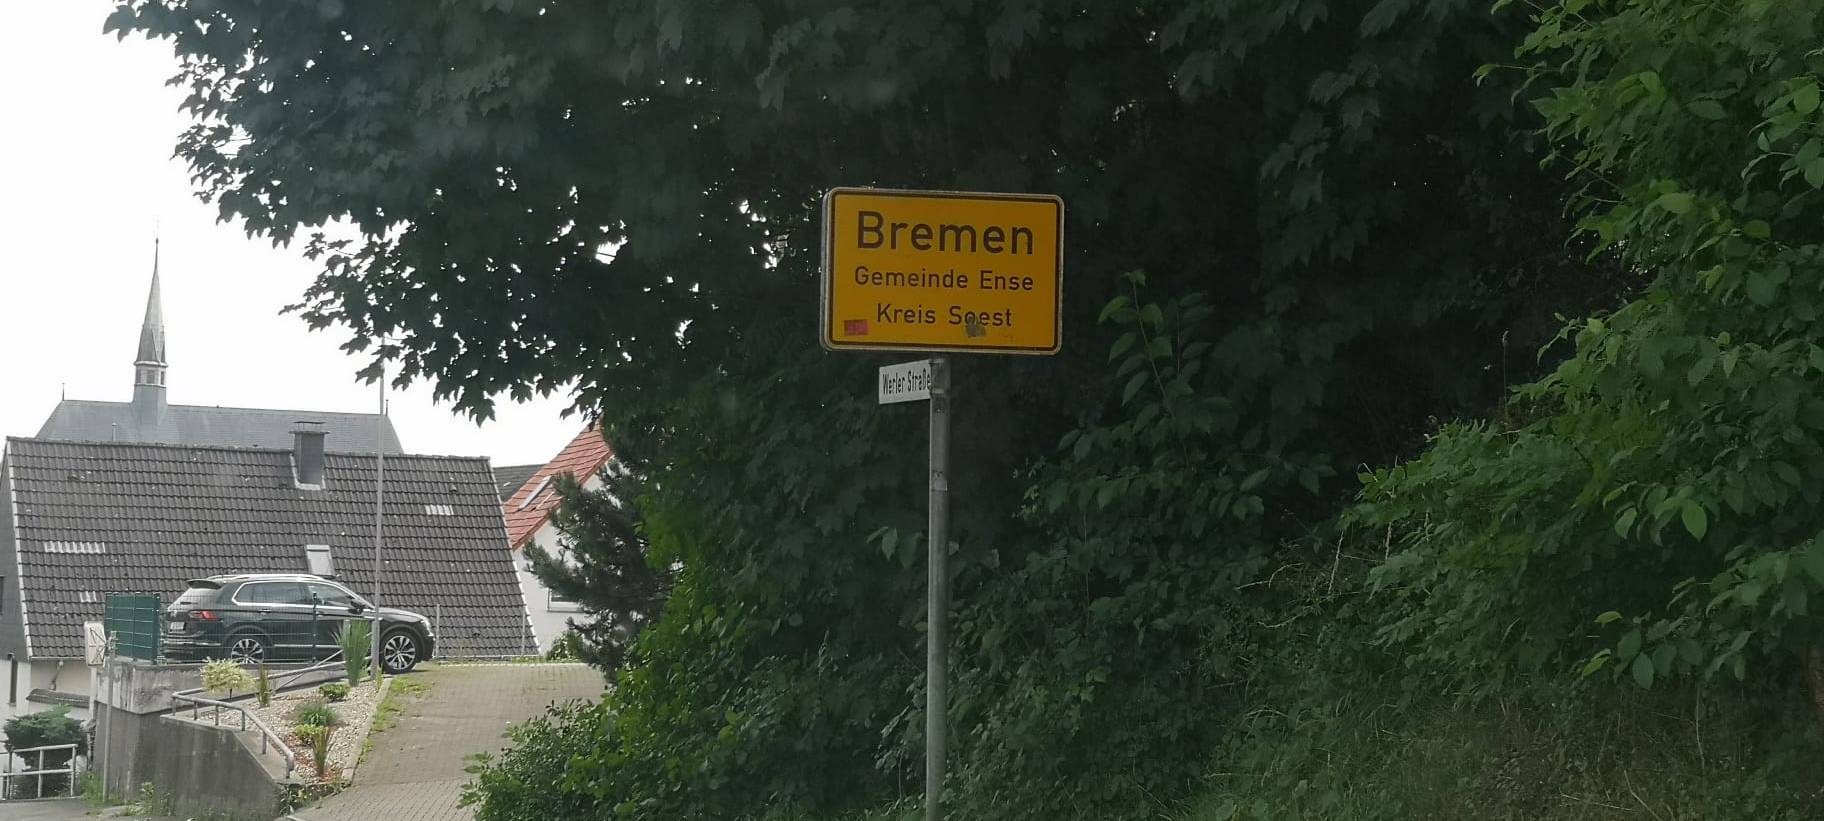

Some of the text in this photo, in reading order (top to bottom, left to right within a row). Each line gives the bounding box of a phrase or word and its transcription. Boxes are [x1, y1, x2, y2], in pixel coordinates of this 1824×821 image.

[858, 211, 1033, 254] Bremen
[855, 266, 1034, 291] Gemeinde Ense
[877, 303, 1012, 327] Kreis Soest
[882, 368, 931, 395] Werler Straße
